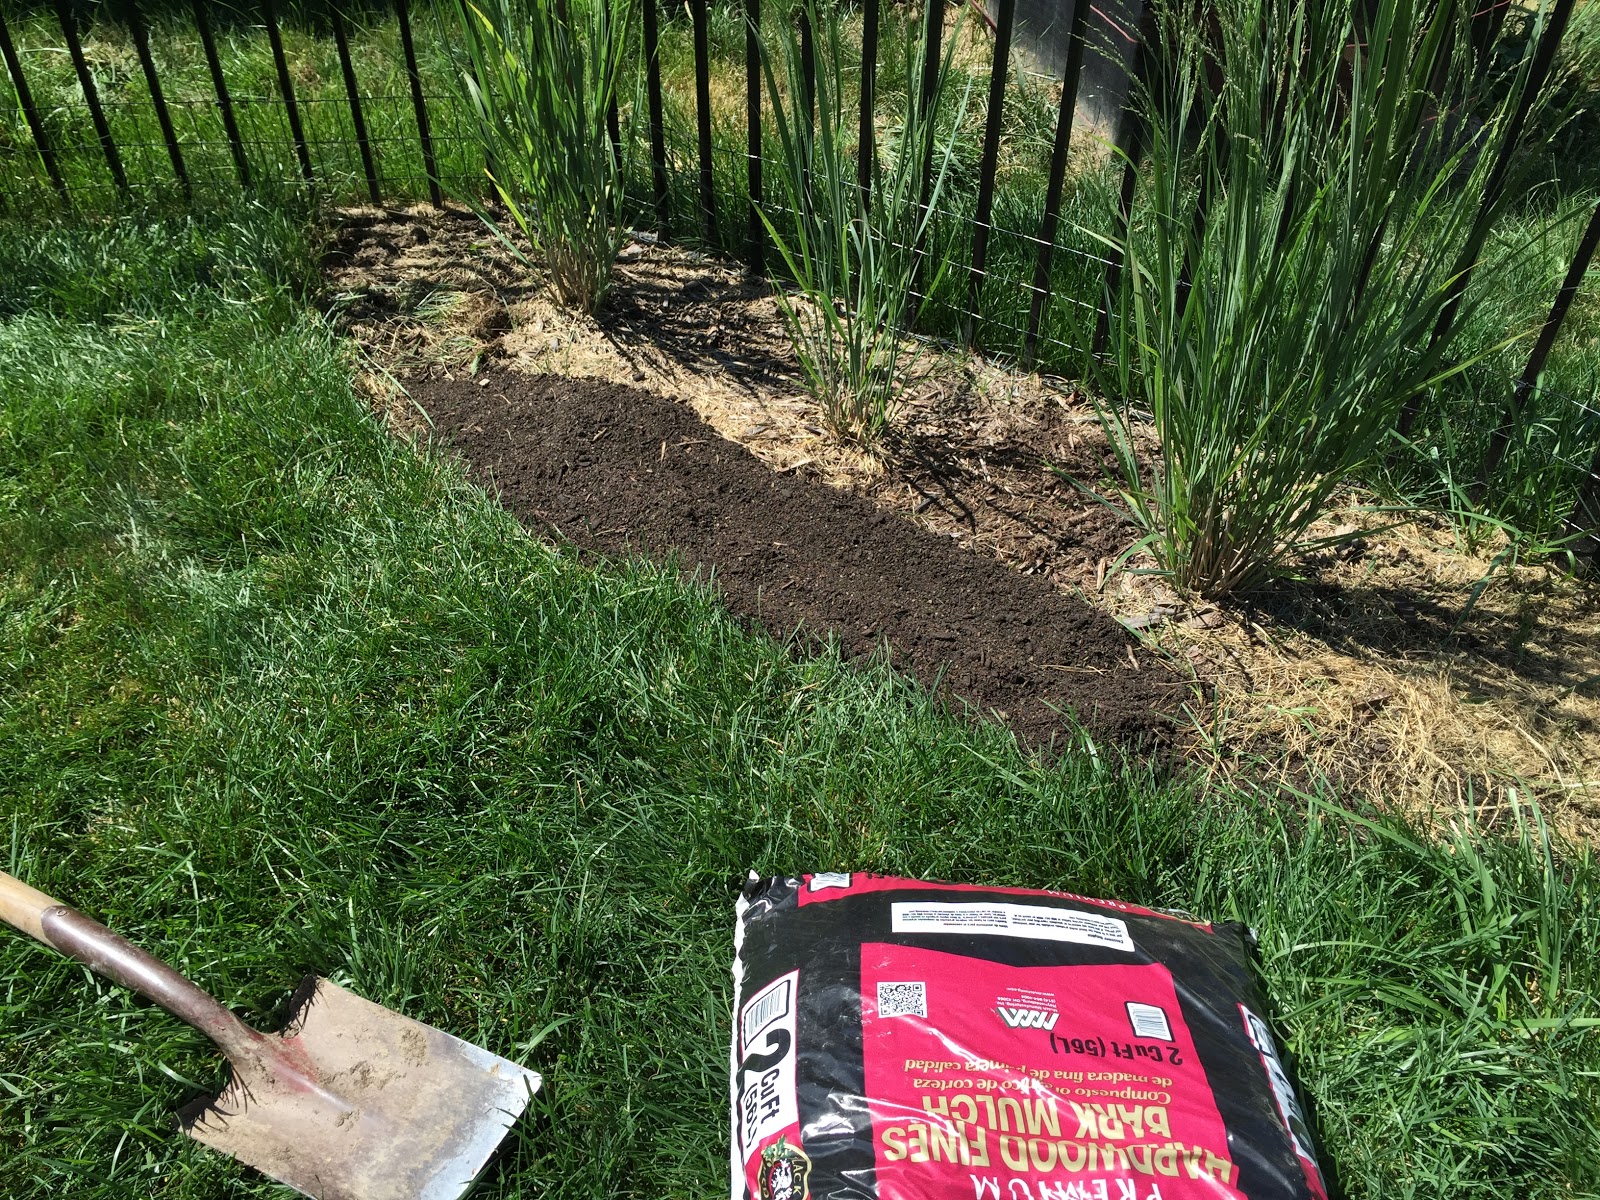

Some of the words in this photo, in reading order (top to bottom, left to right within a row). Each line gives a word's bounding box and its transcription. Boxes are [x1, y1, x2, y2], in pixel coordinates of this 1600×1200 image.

[1050, 1033, 1106, 1057] (56L)
[1166, 1046, 1184, 1066] 2
[904, 1060, 961, 1073] calidad
[1029, 1069, 1050, 1081] de
[913, 1079, 973, 1091] corteza
[976, 1079, 998, 1092] de
[1054, 1070, 1083, 1083] fina
[1087, 1072, 1148, 1085] madera
[1151, 1077, 1173, 1088] de
[1075, 1087, 1171, 1105] Compuesto
[922, 1095, 1062, 1138] MULCH
[1068, 1100, 1171, 1140] BARK
[881, 1120, 990, 1167] FINES
[1000, 1134, 1232, 1185] HARDWOOD
[790, 1157, 805, 1197] LACK
